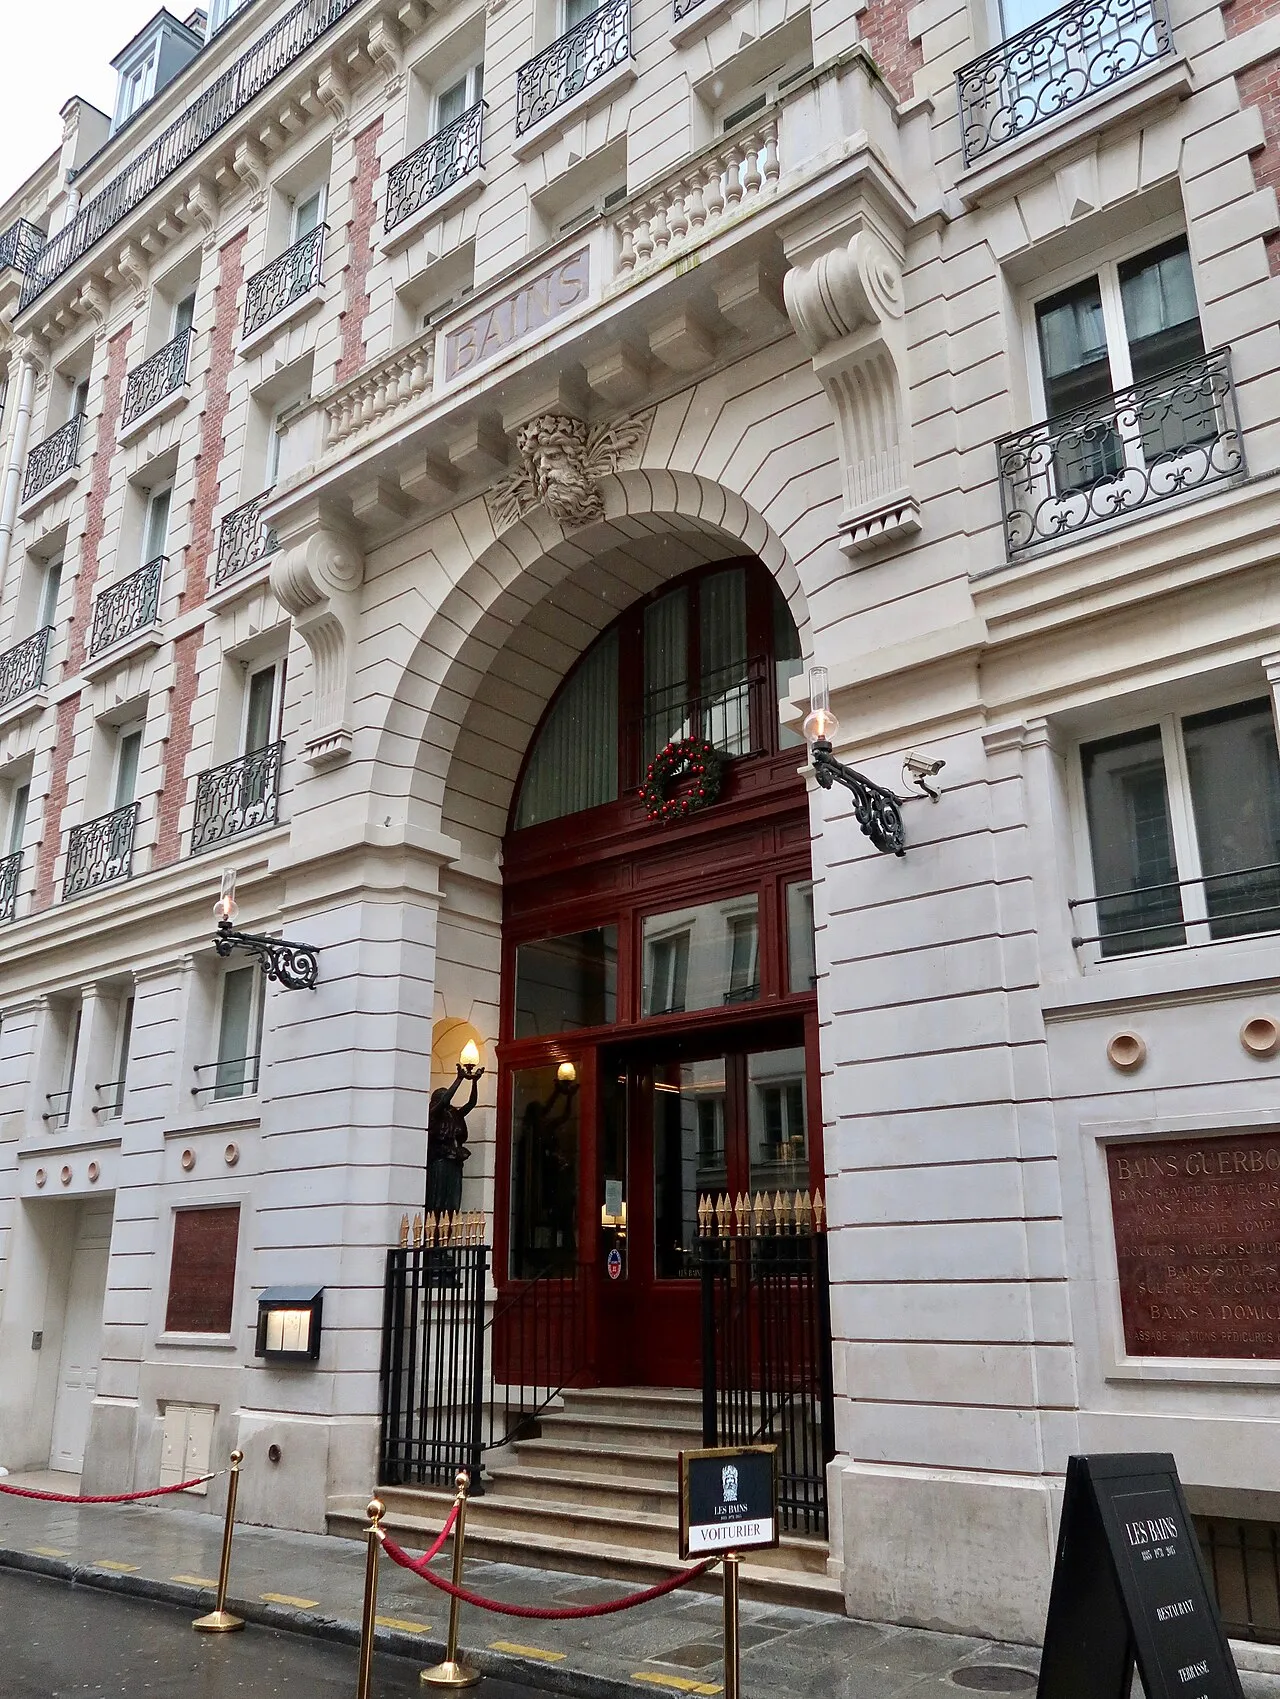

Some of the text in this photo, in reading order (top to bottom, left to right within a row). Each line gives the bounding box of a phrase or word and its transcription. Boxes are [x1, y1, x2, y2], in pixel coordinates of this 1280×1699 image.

[451, 255, 583, 377] BAINS
[1116, 1156, 1179, 1180] BAINS
[1172, 1185, 1220, 1198] VAPEUR
[1222, 1183, 1254, 1196] AVEC
[1167, 1265, 1210, 1278] BAINS
[1150, 1305, 1199, 1320] BAINS
[714, 1503, 748, 1515] LES BAINS
[701, 1523, 761, 1541] VOITURIER
[1125, 1516, 1178, 1546] LES BAINS
[1156, 1599, 1195, 1622] RESTAURANT
[1178, 1659, 1210, 1683] TERRASSE
